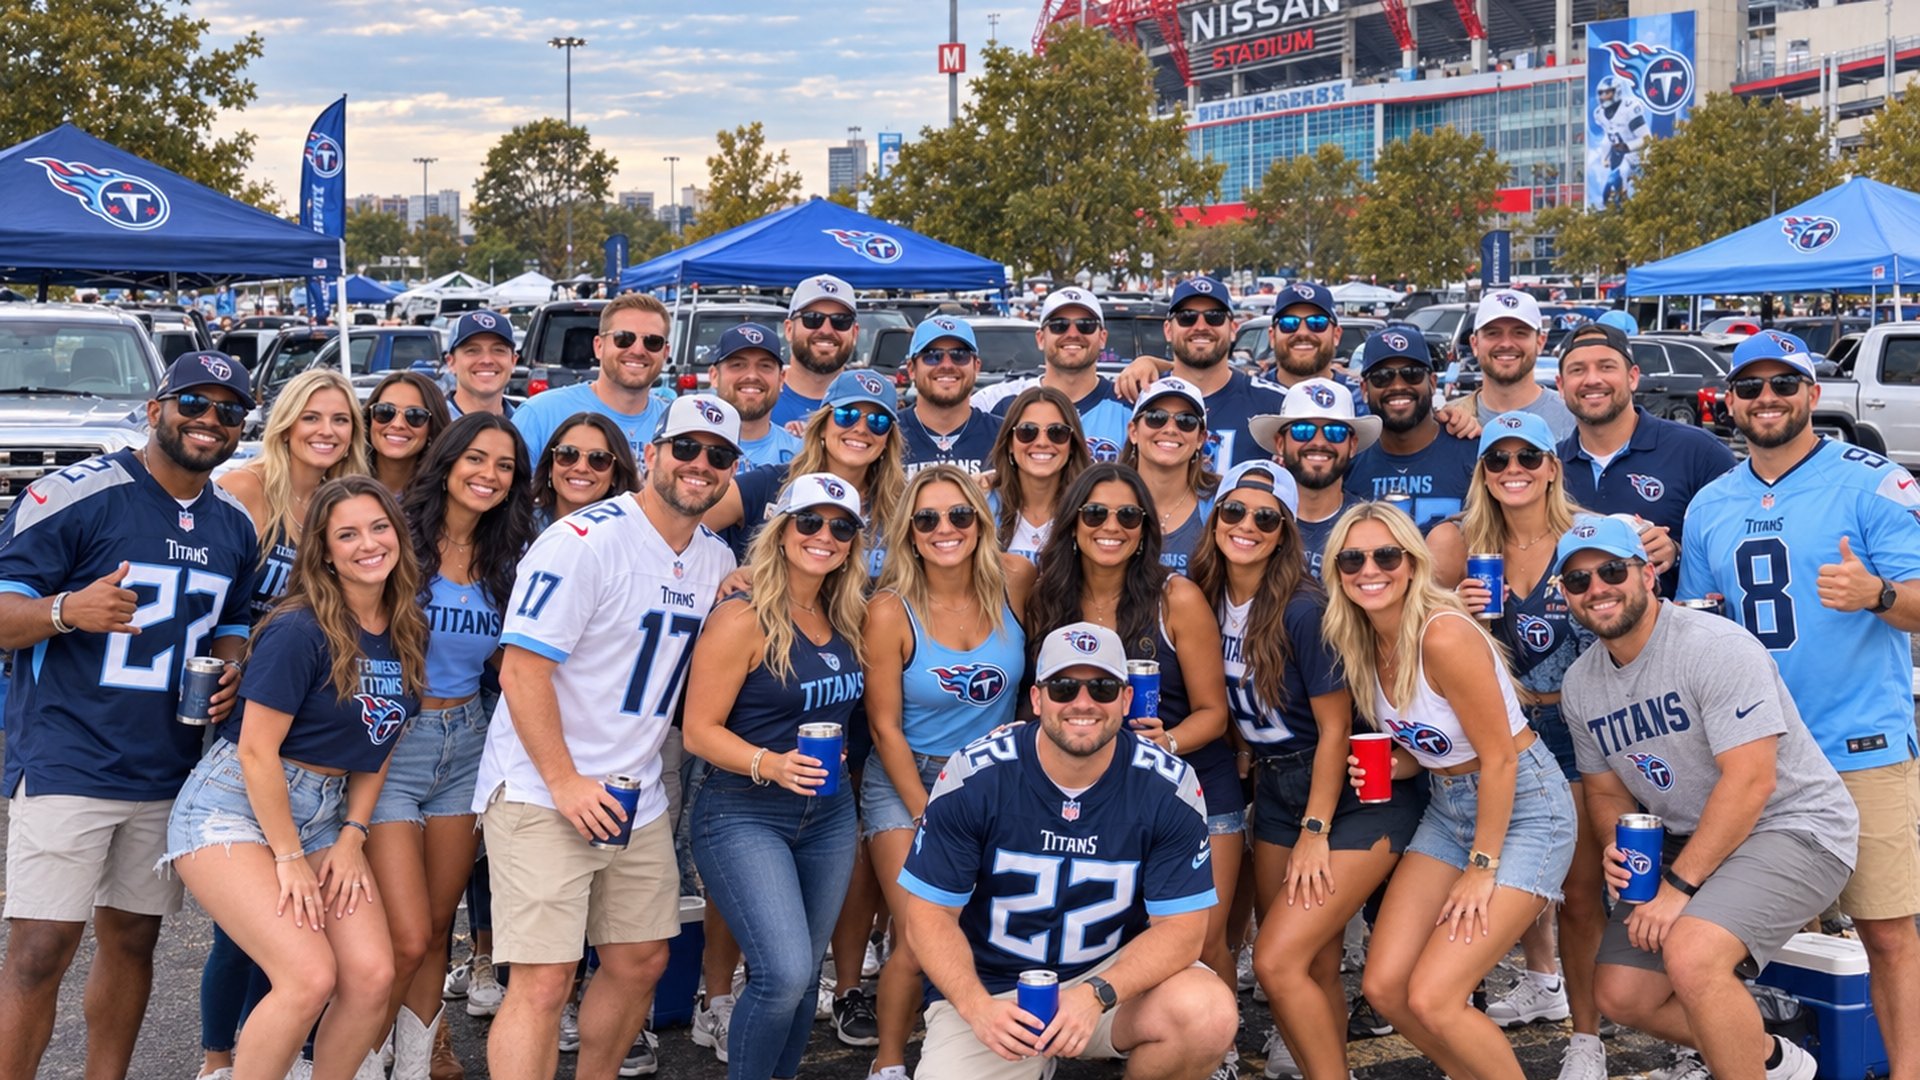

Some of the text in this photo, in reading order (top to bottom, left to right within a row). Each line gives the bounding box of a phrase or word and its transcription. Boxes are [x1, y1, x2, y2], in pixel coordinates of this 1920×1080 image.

[943, 47, 960, 70] M
[1211, 29, 1315, 70] STADIUM
[1372, 476, 1433, 497] TITANS
[1744, 517, 1784, 534] TITANS
[166, 538, 209, 566] TITANS
[516, 571, 564, 621] 17
[661, 585, 696, 609] TITANS
[1733, 536, 1798, 650] 8
[426, 605, 501, 638] TITANS
[619, 608, 703, 717] 17
[800, 671, 865, 712] TITANS
[1587, 691, 1691, 757] TITANS
[1041, 829, 1099, 856] TITANS
[988, 847, 1141, 965] 22
